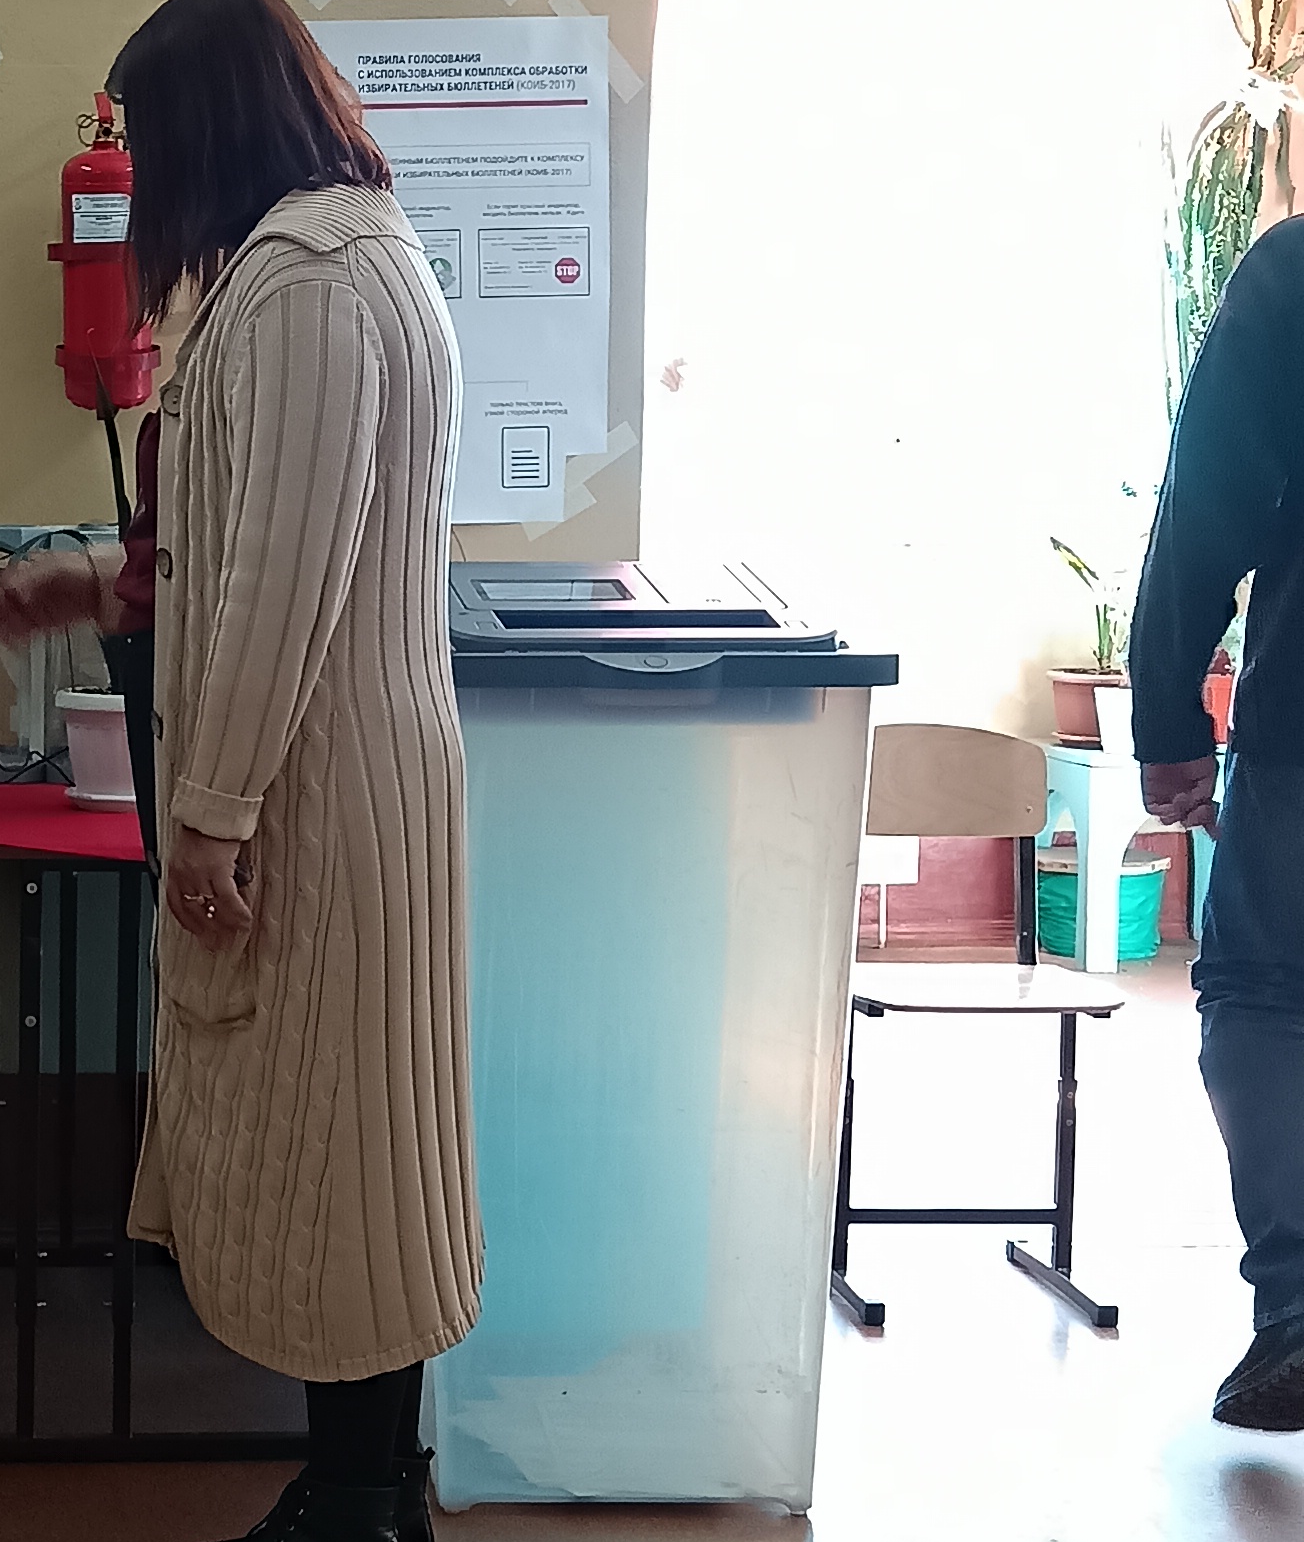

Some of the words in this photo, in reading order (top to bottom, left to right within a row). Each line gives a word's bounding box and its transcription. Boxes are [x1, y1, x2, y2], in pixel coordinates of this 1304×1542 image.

[357, 55, 406, 65] ПРАВИЛА
[408, 53, 481, 64] ГОЛОСОВАНИЯ
[357, 69, 365, 79] С
[367, 67, 462, 79] ИСПОЛЬЗОВАНИЕМ
[465, 66, 526, 77] КОМПЛЕКСА
[528, 65, 588, 76] ОБРАБОТКИ
[358, 82, 445, 94] ИЗБИРАТЕЛЬНЫХ
[447, 79, 515, 92] БЮЛЛЕТЕНЕЙ
[516, 79, 576, 92] (КОИБ-2017)
[556, 265, 579, 277] STOP
